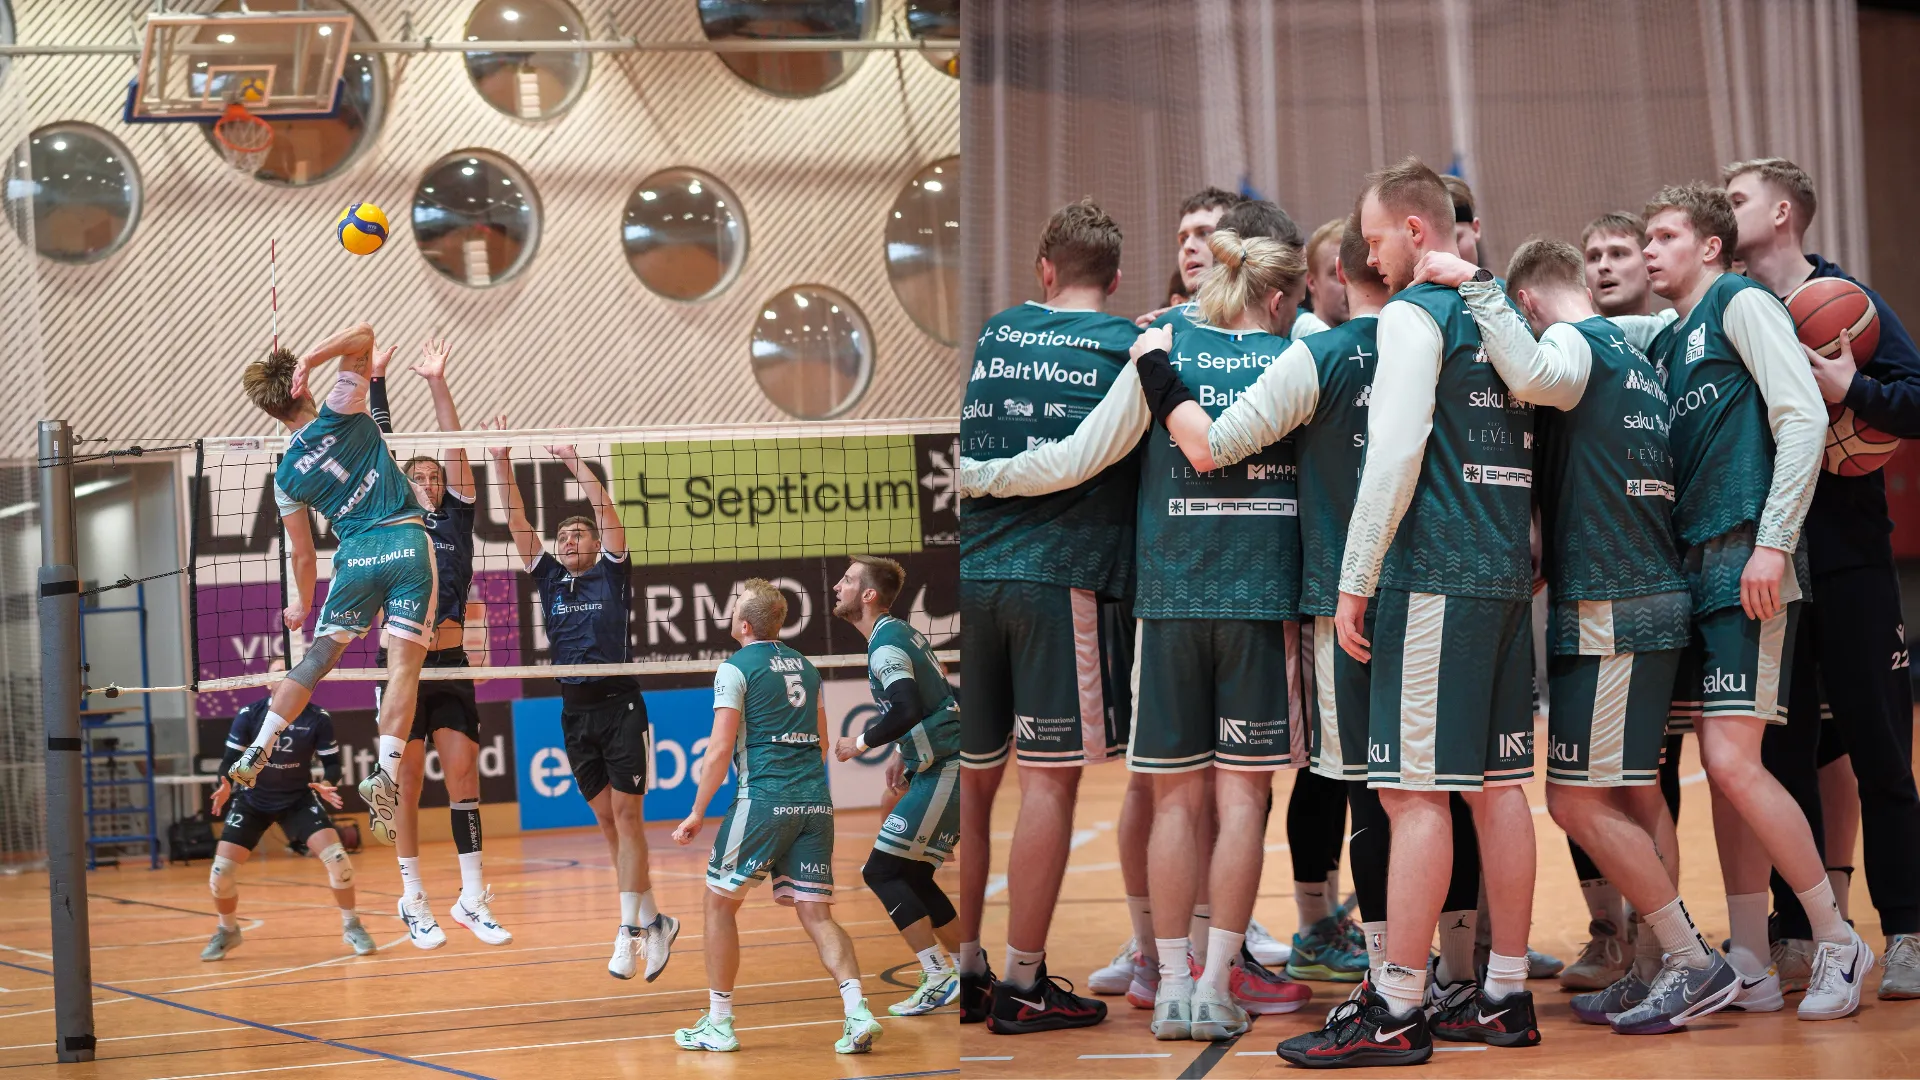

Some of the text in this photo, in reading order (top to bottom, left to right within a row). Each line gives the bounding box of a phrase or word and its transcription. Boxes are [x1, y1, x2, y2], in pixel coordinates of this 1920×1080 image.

[996, 325, 1100, 349] Septicum
[989, 358, 1097, 386] BaltWood
[1200, 385, 1249, 407] Balt
[1468, 387, 1504, 409] saku
[963, 399, 993, 420] saku
[1623, 411, 1655, 430] saku
[1468, 428, 1514, 445] LEVEL
[320, 456, 350, 484] 1
[685, 473, 914, 527] Septicum
[1191, 502, 1295, 512] SKARCON
[347, 548, 416, 568] SPORT.EMU.EE
[769, 656, 804, 672] JÄRV
[1892, 649, 1910, 670] 22
[783, 673, 806, 707] 5
[1703, 667, 1746, 693] saku
[1036, 716, 1076, 724] International
[1249, 718, 1287, 728] International
[1249, 728, 1284, 736] Aluminium
